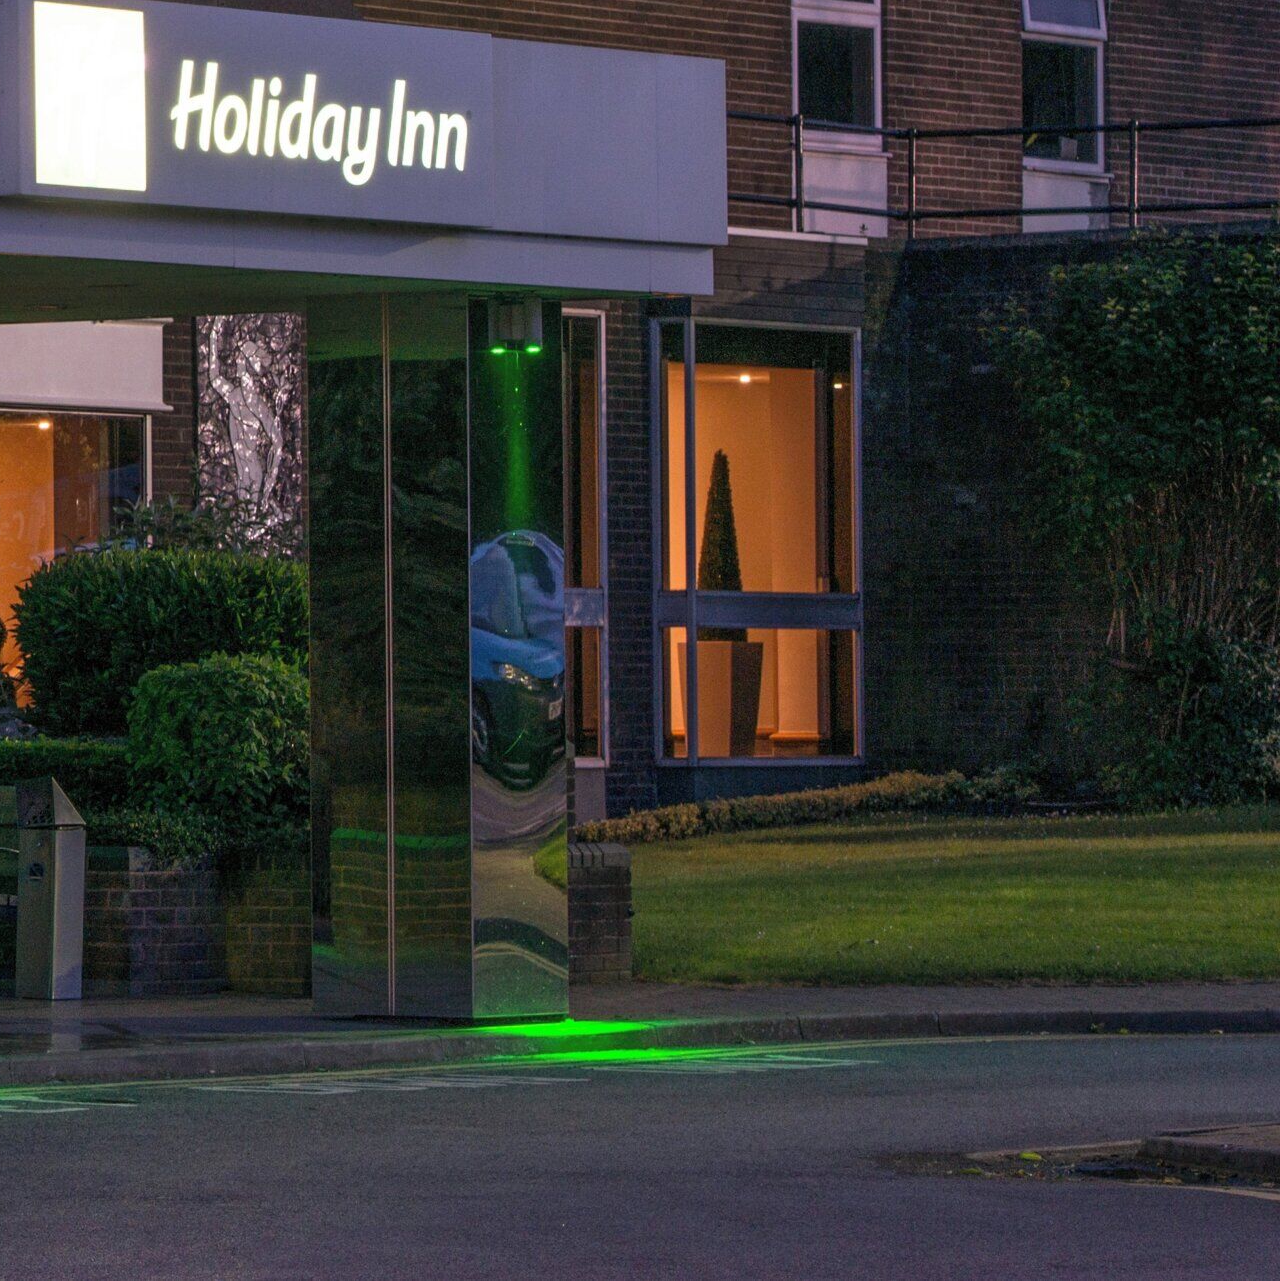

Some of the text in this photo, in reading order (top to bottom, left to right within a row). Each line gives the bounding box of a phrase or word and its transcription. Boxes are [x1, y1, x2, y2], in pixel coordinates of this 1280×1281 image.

[170, 59, 468, 186] Holiday Inn
[580, 1054, 880, 1075] ONLY
